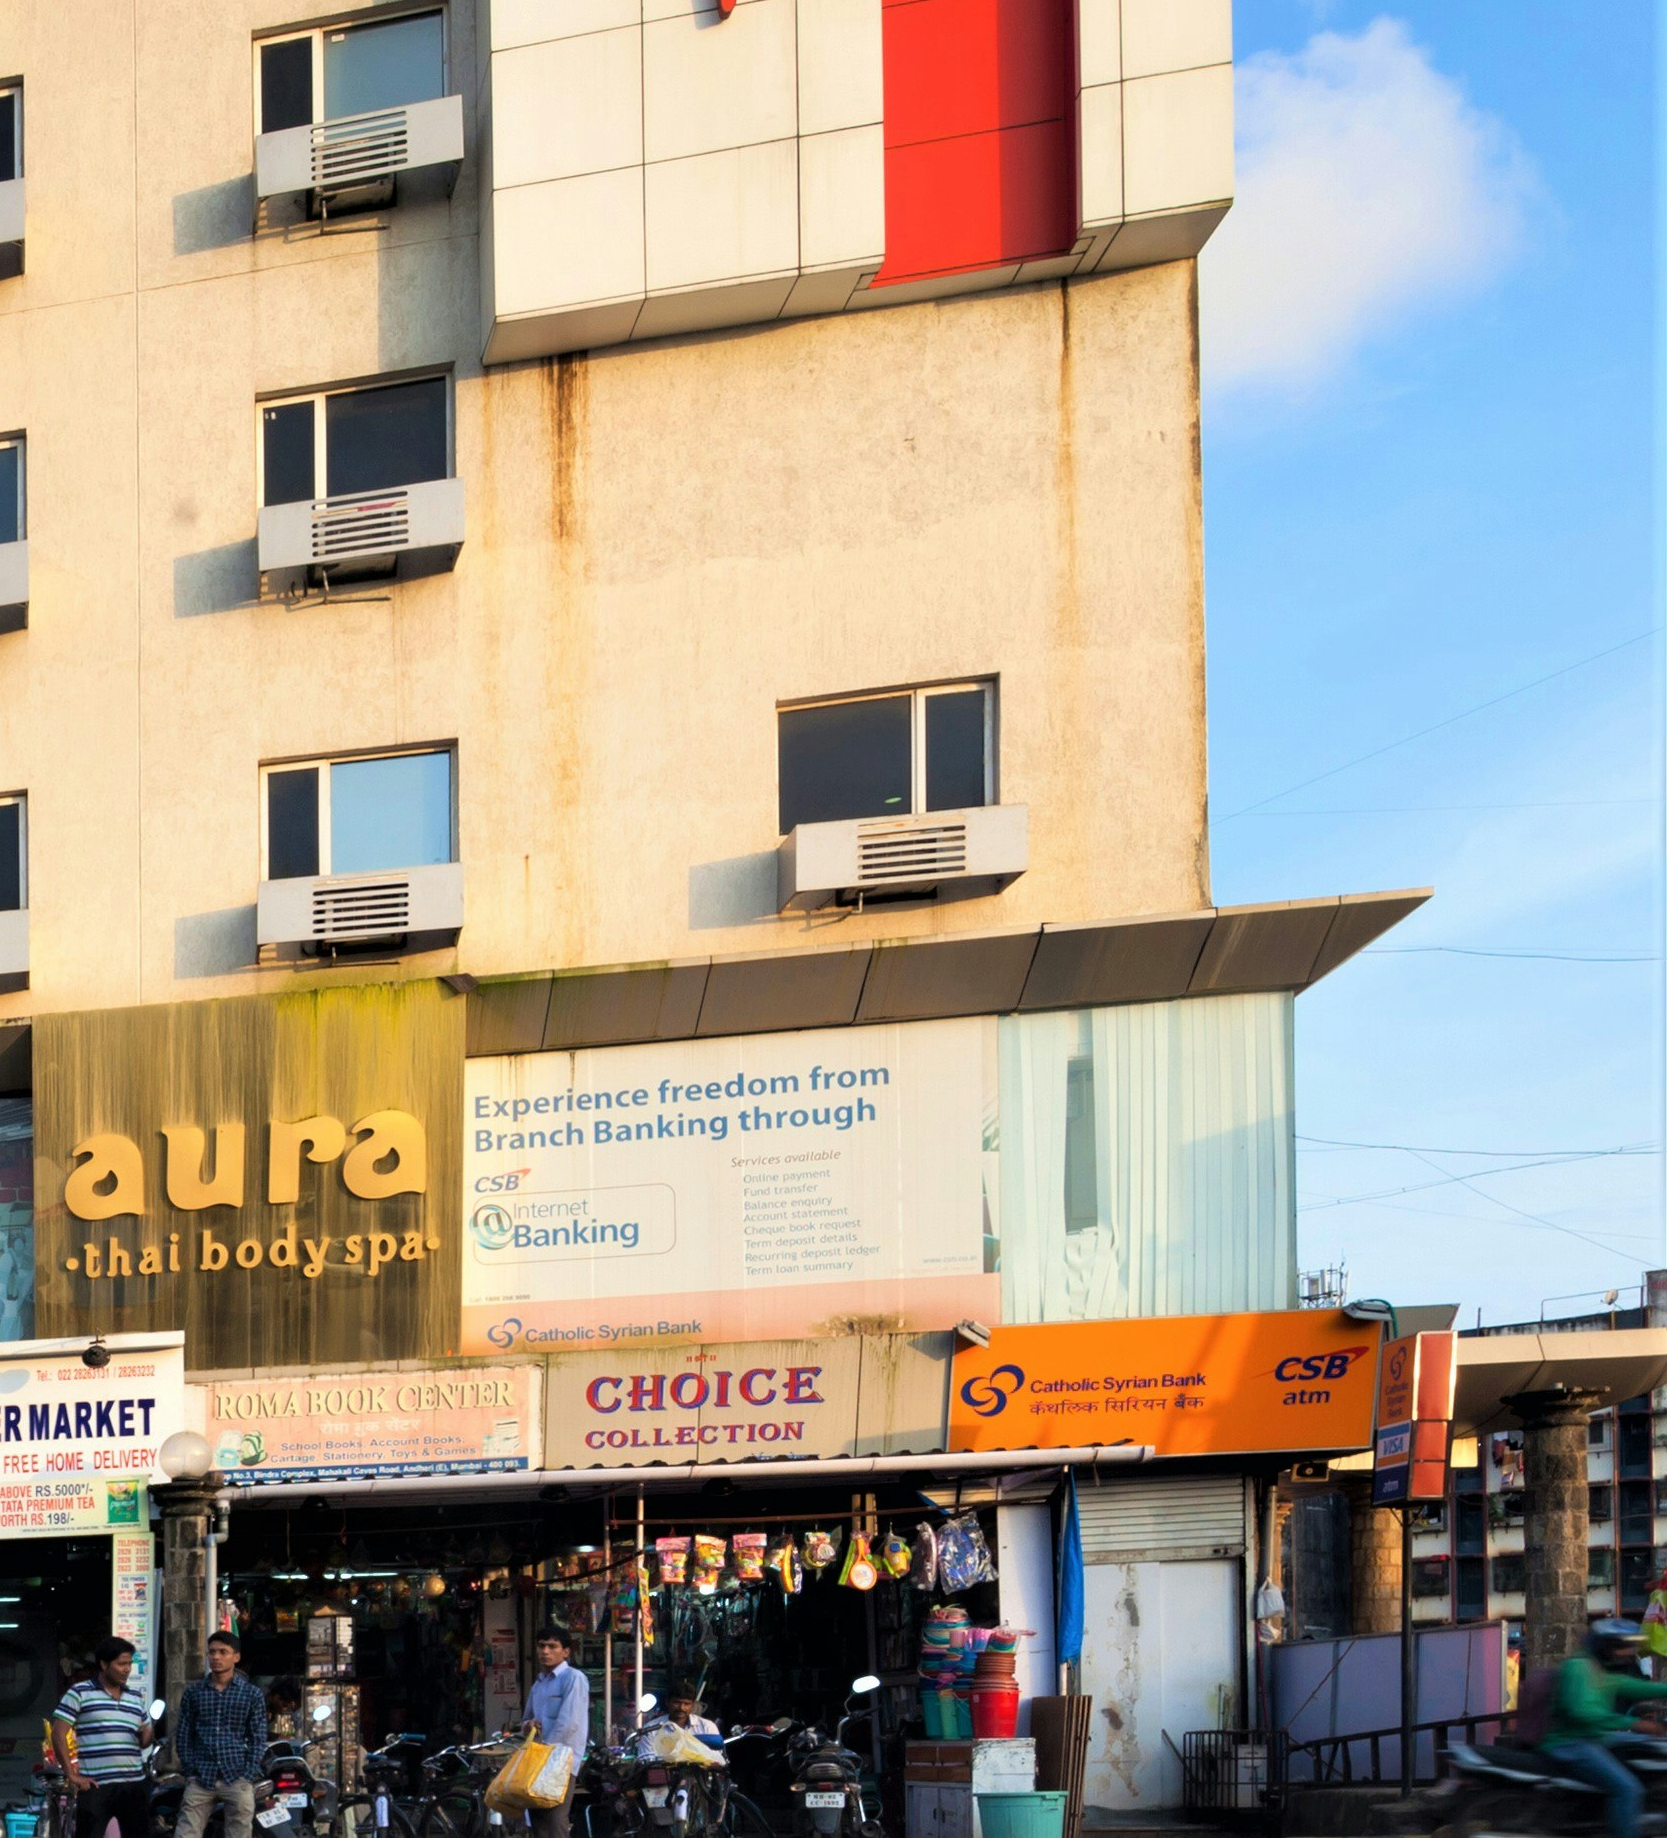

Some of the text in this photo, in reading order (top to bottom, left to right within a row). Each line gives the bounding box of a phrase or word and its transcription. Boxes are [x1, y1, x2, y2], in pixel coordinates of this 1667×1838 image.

[474, 1065, 889, 1122] Experience freedom from
[475, 1097, 876, 1152] Branch Banking through
[65, 1110, 426, 1220] aura
[731, 1150, 841, 1167] Services available
[475, 1174, 519, 1193] CSB
[743, 1169, 831, 1184] Online payment
[744, 1184, 818, 1197] Fund transfer
[514, 1199, 588, 1219] Internet
[792, 1207, 848, 1218] statement
[514, 1219, 639, 1248] Banking
[84, 1225, 425, 1278] thai body spa
[801, 1245, 880, 1259] deposit ledger
[803, 1261, 853, 1272] summary
[525, 1320, 702, 1342] Catholic Syrian Bank
[1275, 1355, 1349, 1382] CSB
[586, 1367, 826, 1413] CHOICE
[1030, 1372, 1206, 1393] Catholic Syrian Bank
[216, 1380, 515, 1420] ROMA BOOK CENTER
[1282, 1389, 1330, 1405] atm
[29, 1399, 155, 1441] MARKET
[281, 1438, 419, 1451] School Account
[585, 1421, 805, 1449] COLLECTION
[390, 1447, 476, 1458] Toys Games
[1383, 1436, 1404, 1456] VISA
[4, 1448, 157, 1474] FREE HOME DELIVERY
[254, 1471, 279, 1479] Bindra
[0, 1485, 32, 1499] ABOVE
[1383, 1479, 1399, 1492] atm
[1, 1499, 24, 1513] TATA
[26, 1497, 74, 1512] PREMIUM
[77, 1496, 95, 1509] TEA
